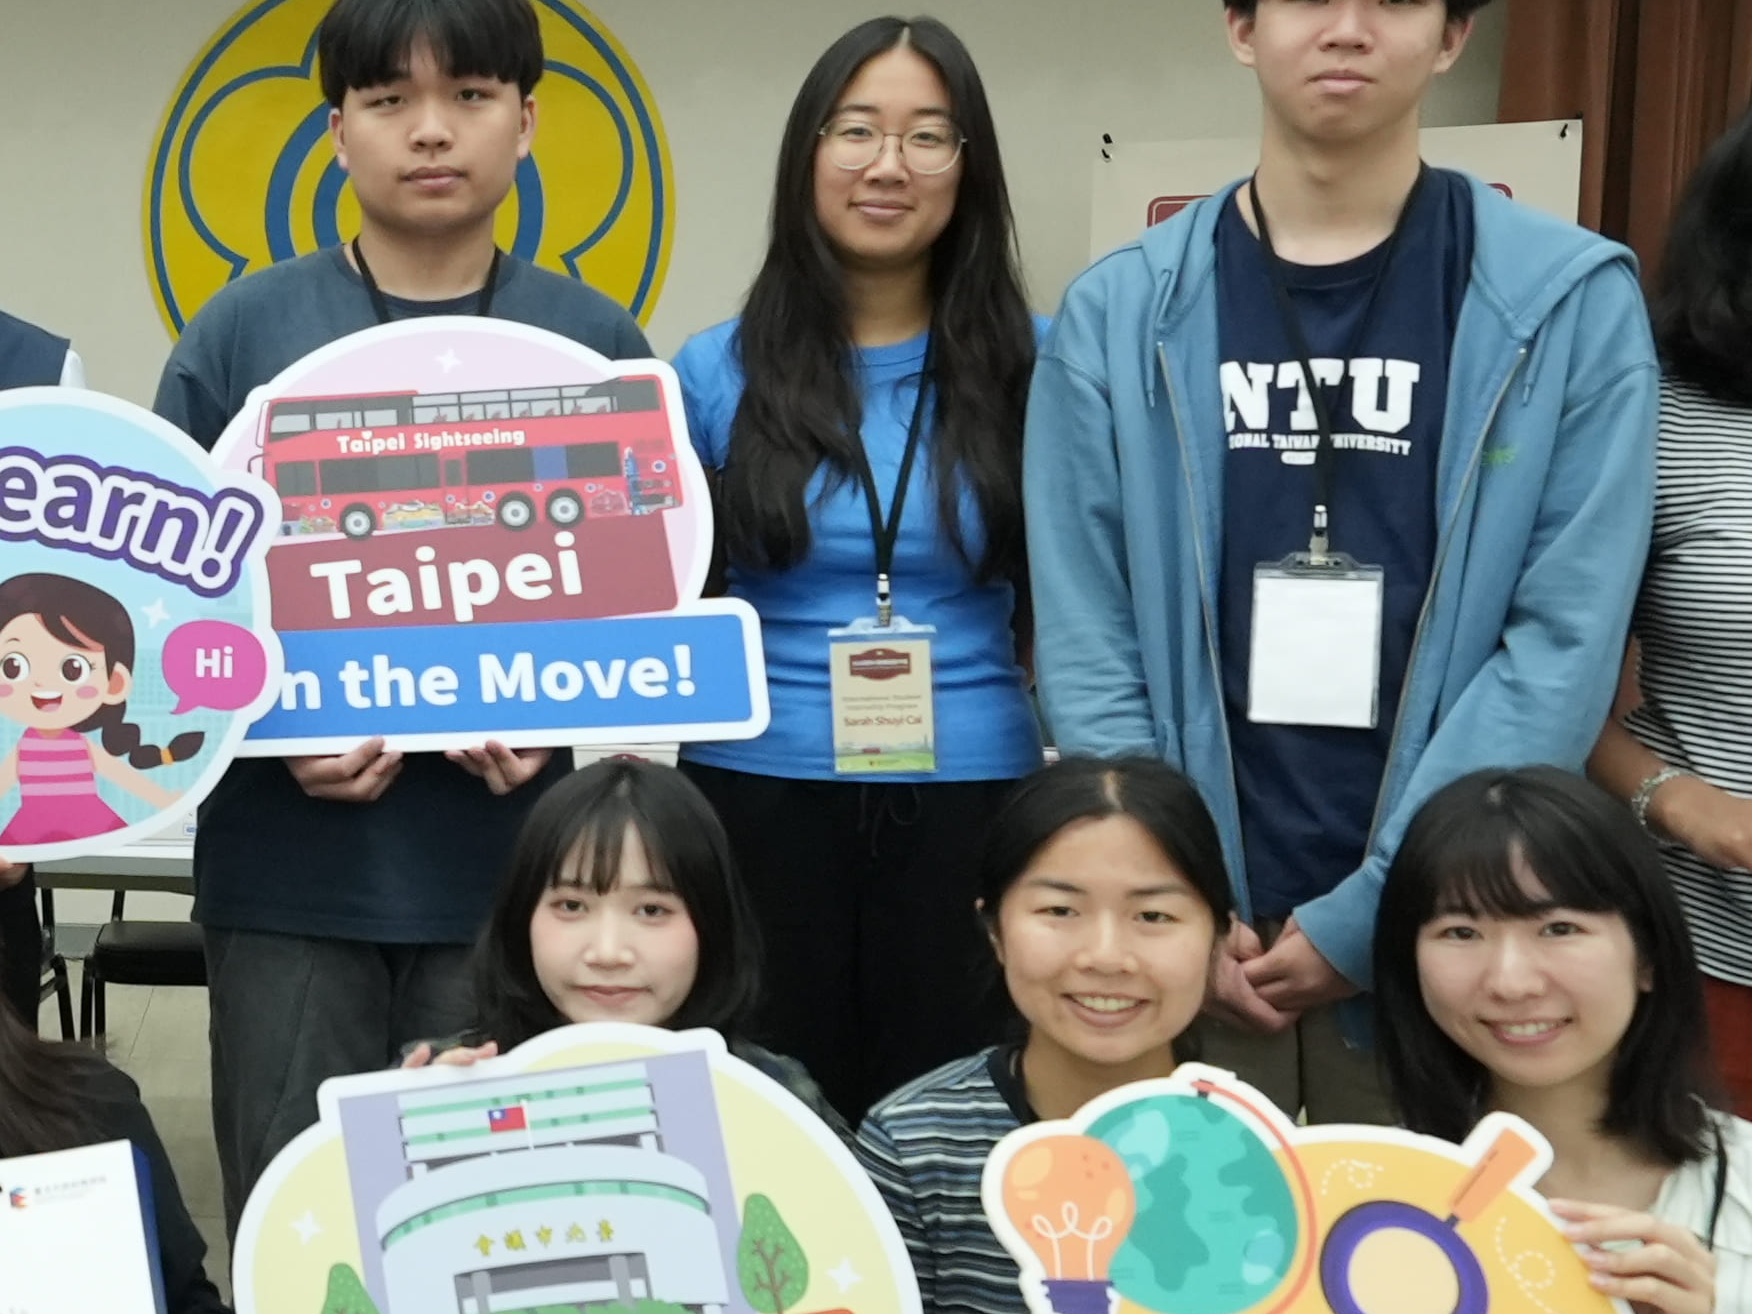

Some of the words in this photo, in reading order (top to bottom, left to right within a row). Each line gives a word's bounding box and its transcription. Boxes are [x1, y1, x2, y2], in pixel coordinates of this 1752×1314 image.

[1219, 357, 1421, 435] NTU
[337, 431, 406, 455] Taipei
[413, 427, 526, 451] Sightseeing
[309, 531, 584, 623] Taipei
[195, 645, 235, 679] Hi
[339, 653, 460, 708] the
[478, 644, 697, 705] Move!
